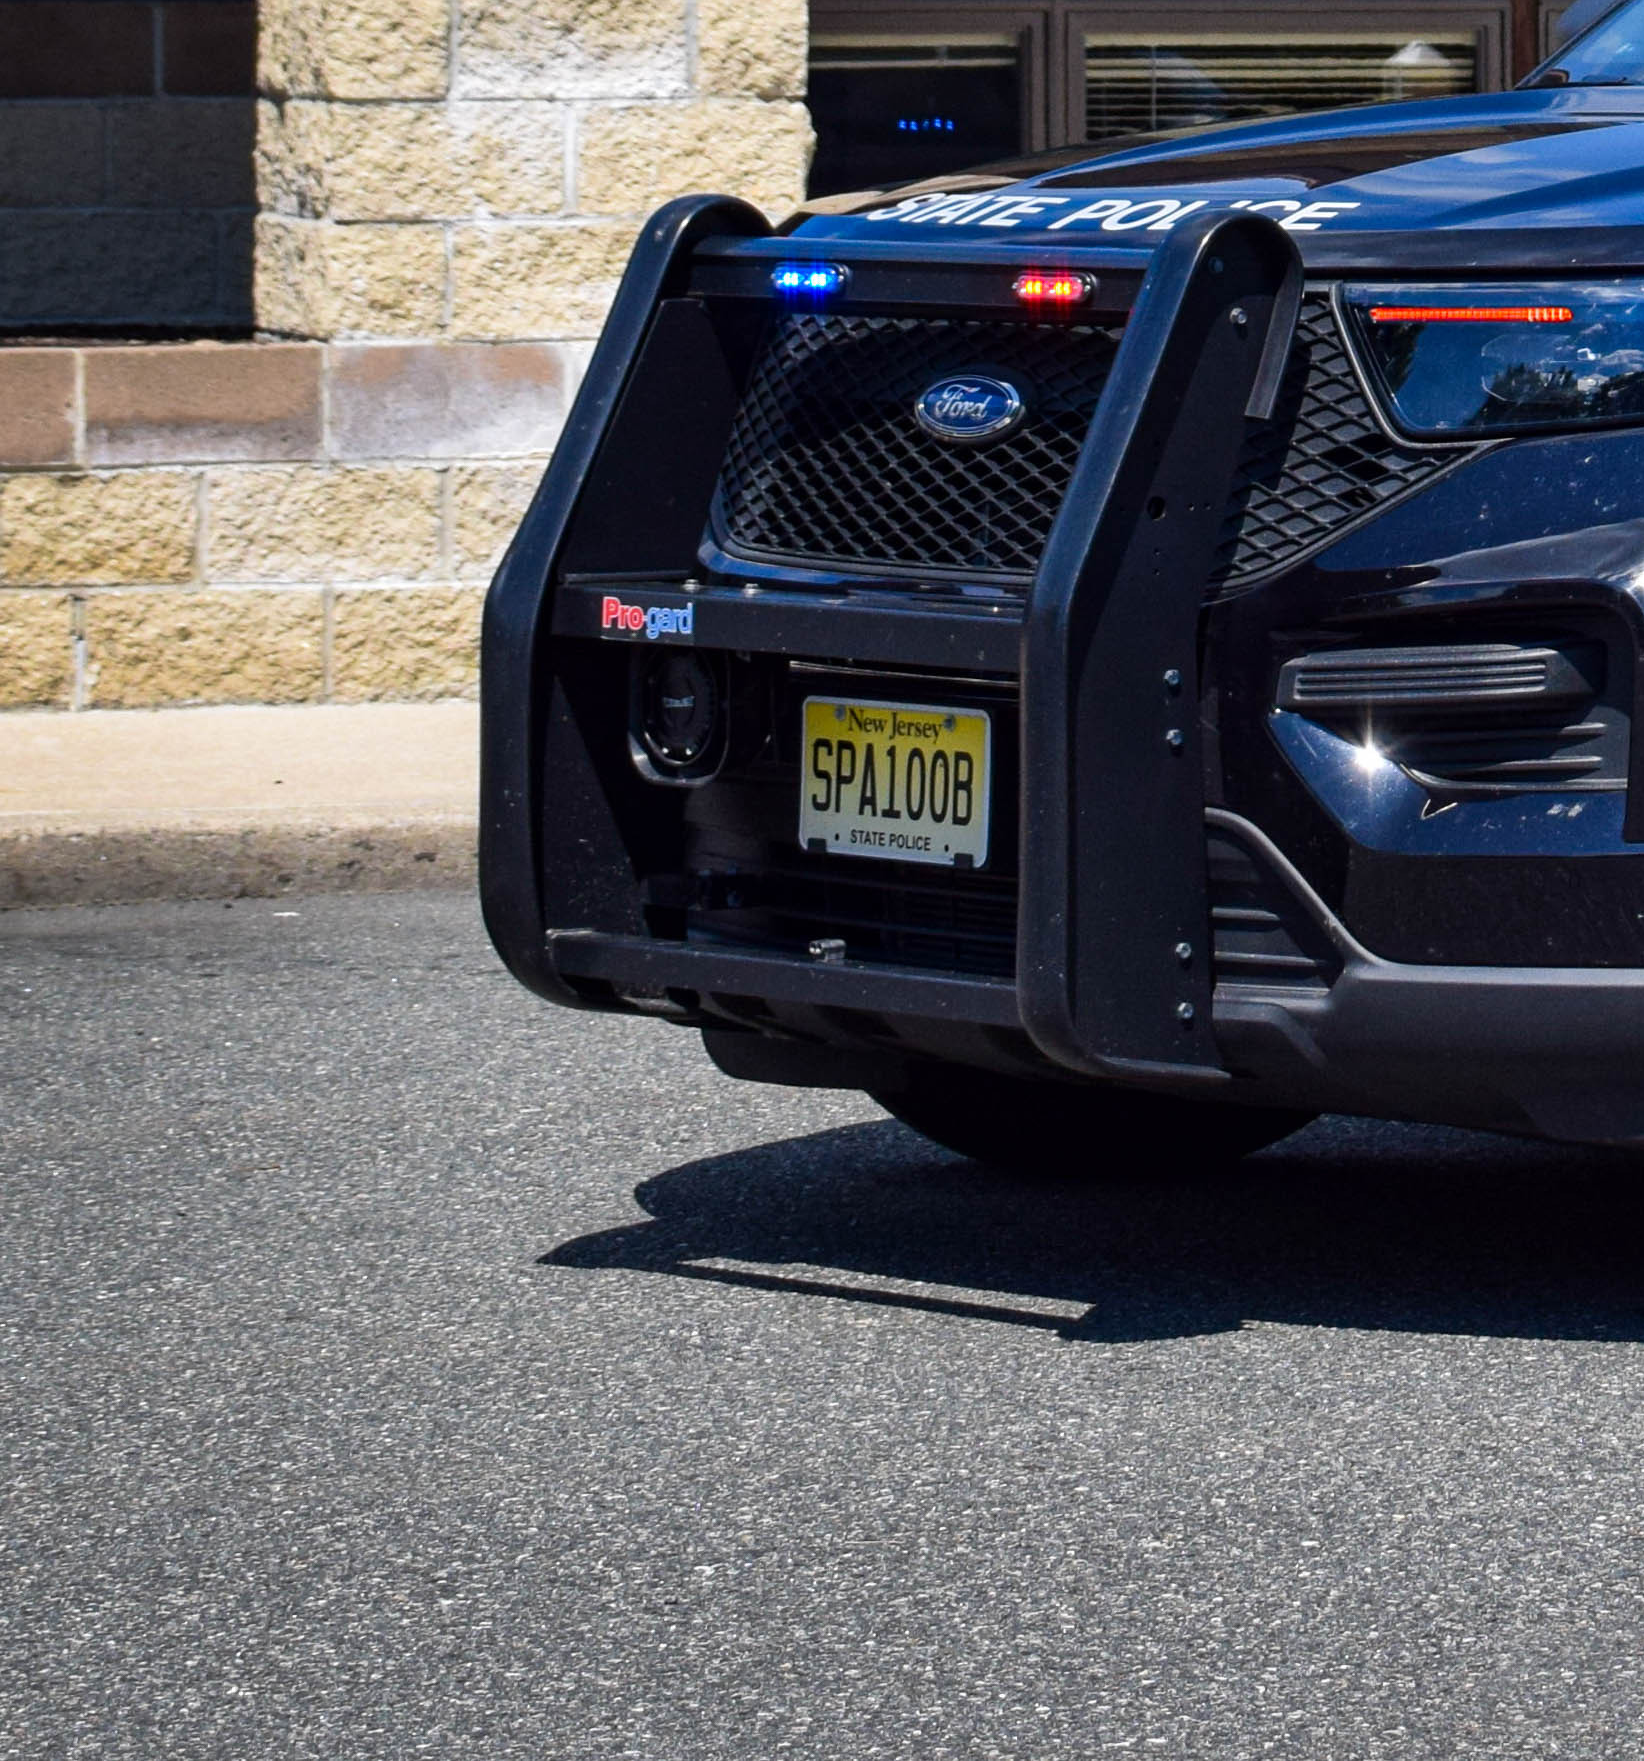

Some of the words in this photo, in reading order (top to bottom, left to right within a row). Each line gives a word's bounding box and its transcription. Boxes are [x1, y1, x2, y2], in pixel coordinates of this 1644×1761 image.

[867, 193, 1071, 226] STATE
[1047, 200, 1361, 230] POLCE
[935, 383, 993, 419] Ford
[602, 596, 693, 639] Pro-gard
[848, 707, 888, 733] New
[889, 711, 943, 744] Jersey
[811, 737, 974, 827] SPA100B
[850, 829, 886, 847] STATE
[889, 833, 932, 852] POLICE
